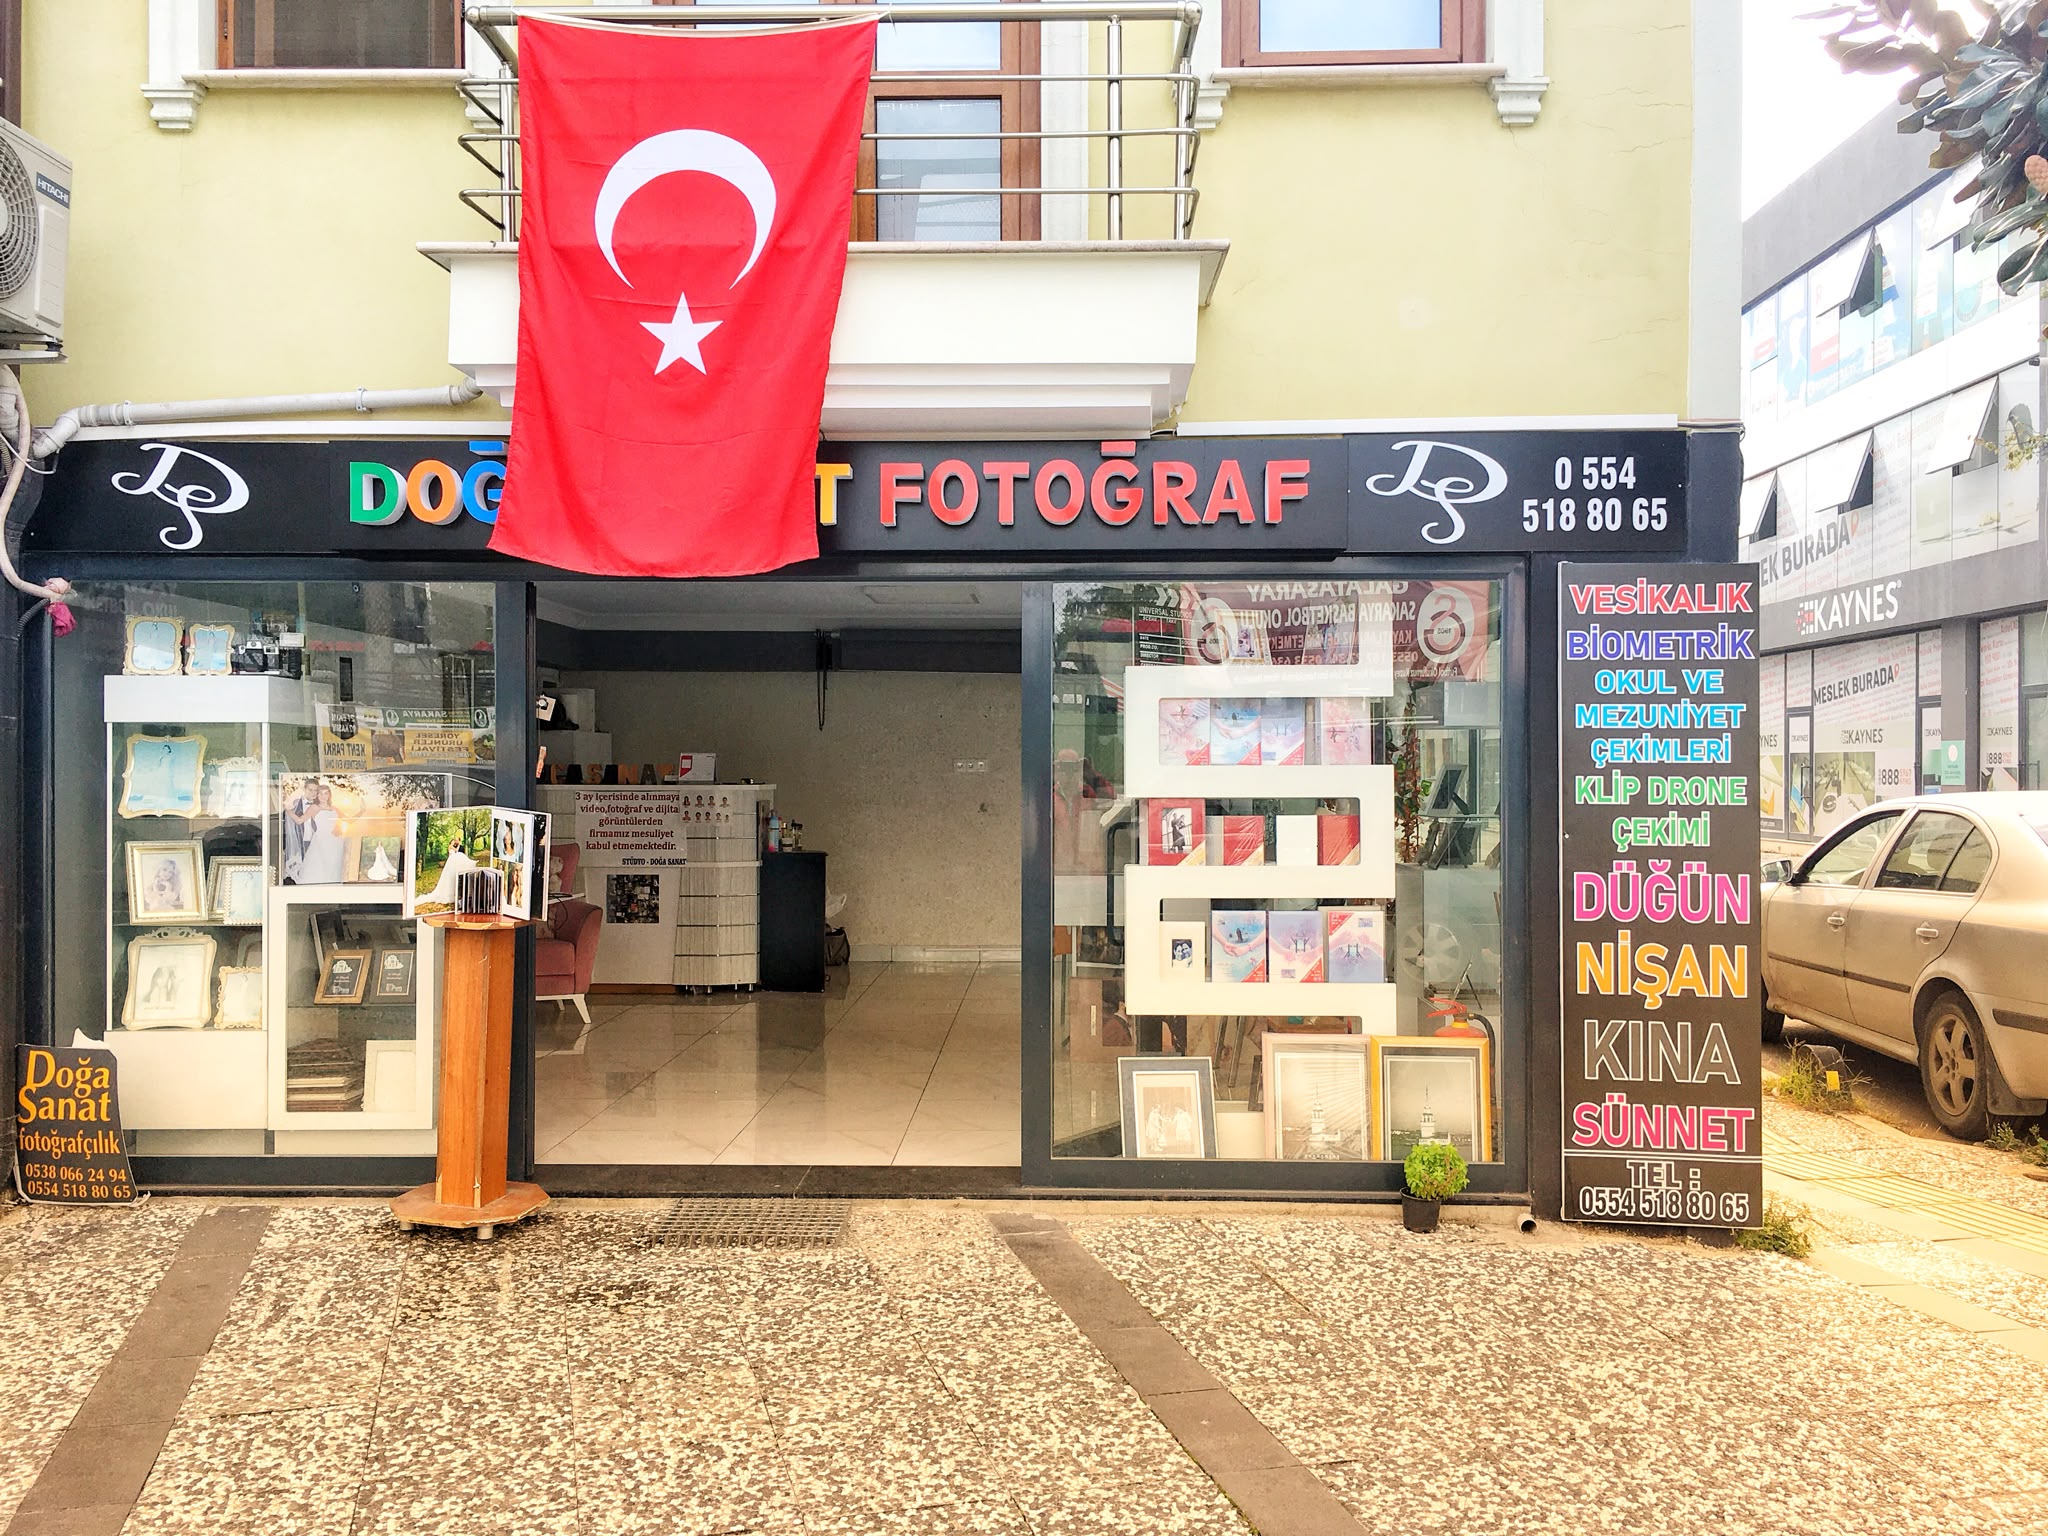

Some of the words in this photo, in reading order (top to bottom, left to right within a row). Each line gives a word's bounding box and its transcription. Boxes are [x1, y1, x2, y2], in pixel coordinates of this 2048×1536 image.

[37, 178, 69, 203] HITACHI
[349, 440, 508, 527] DOĞ
[879, 441, 1311, 528] FOTOĞRAF
[1554, 456, 1572, 491] 0
[1581, 456, 1636, 491] 554
[1522, 498, 1576, 532] 518
[1586, 497, 1622, 532] 80
[1632, 497, 1668, 531] 65
[1783, 517, 1851, 576] BURADA
[1139, 607, 1169, 616] UNIVERSAL
[1568, 578, 1753, 614] VESİKALIK
[1567, 623, 1755, 660] BİOMETRİK
[1594, 669, 1676, 694] OKUL
[1682, 669, 1724, 694] VE
[1814, 678, 1851, 706] MESLEK
[1852, 664, 1895, 694] BURADA
[1575, 699, 1746, 728] MEZUNİYET
[1760, 735, 1778, 748] YNES
[1848, 728, 1883, 744] KAYNES
[1928, 728, 1942, 737] KAYN
[1591, 733, 1731, 768] ÇEKİMLERİ
[1989, 752, 2002, 764] 888
[1575, 770, 1640, 804] KLİP
[1648, 776, 1747, 805] DRONE
[1881, 768, 1899, 785] 888
[575, 791, 581, 801] 3
[583, 794, 594, 802] ay
[641, 792, 680, 803] alınmaya
[589, 829, 630, 838] firmamız
[631, 829, 674, 840] mesuliyet
[599, 816, 663, 828] görüntülerden
[1612, 811, 1710, 852] ÇEKİMİ
[586, 841, 611, 850] kabul
[613, 841, 677, 850] etmemektedir.
[668, 858, 687, 866] SANAT
[1573, 859, 1751, 925] DÜĞÜN
[1576, 930, 1748, 1010] NİŞAN
[1584, 1019, 1741, 1085] KINA
[26, 1050, 110, 1099] Doğa
[18, 1085, 112, 1124] Sanat
[1572, 1092, 1755, 1152] SÜNNET
[19, 1127, 121, 1160] fotoğrafçılık
[25, 1163, 56, 1178] 0538
[60, 1166, 83, 1181] 066
[88, 1168, 105, 1182] 24
[109, 1168, 127, 1182] 94
[1626, 1160, 1682, 1190] TEL
[27, 1181, 59, 1196] 0554
[63, 1183, 87, 1198] 518
[91, 1184, 109, 1198] 80
[113, 1185, 131, 1199] 65
[1579, 1186, 1635, 1217] 0554
[1639, 1188, 1682, 1219] 518
[1686, 1190, 1716, 1221] 80
[1719, 1192, 1749, 1223] 65
